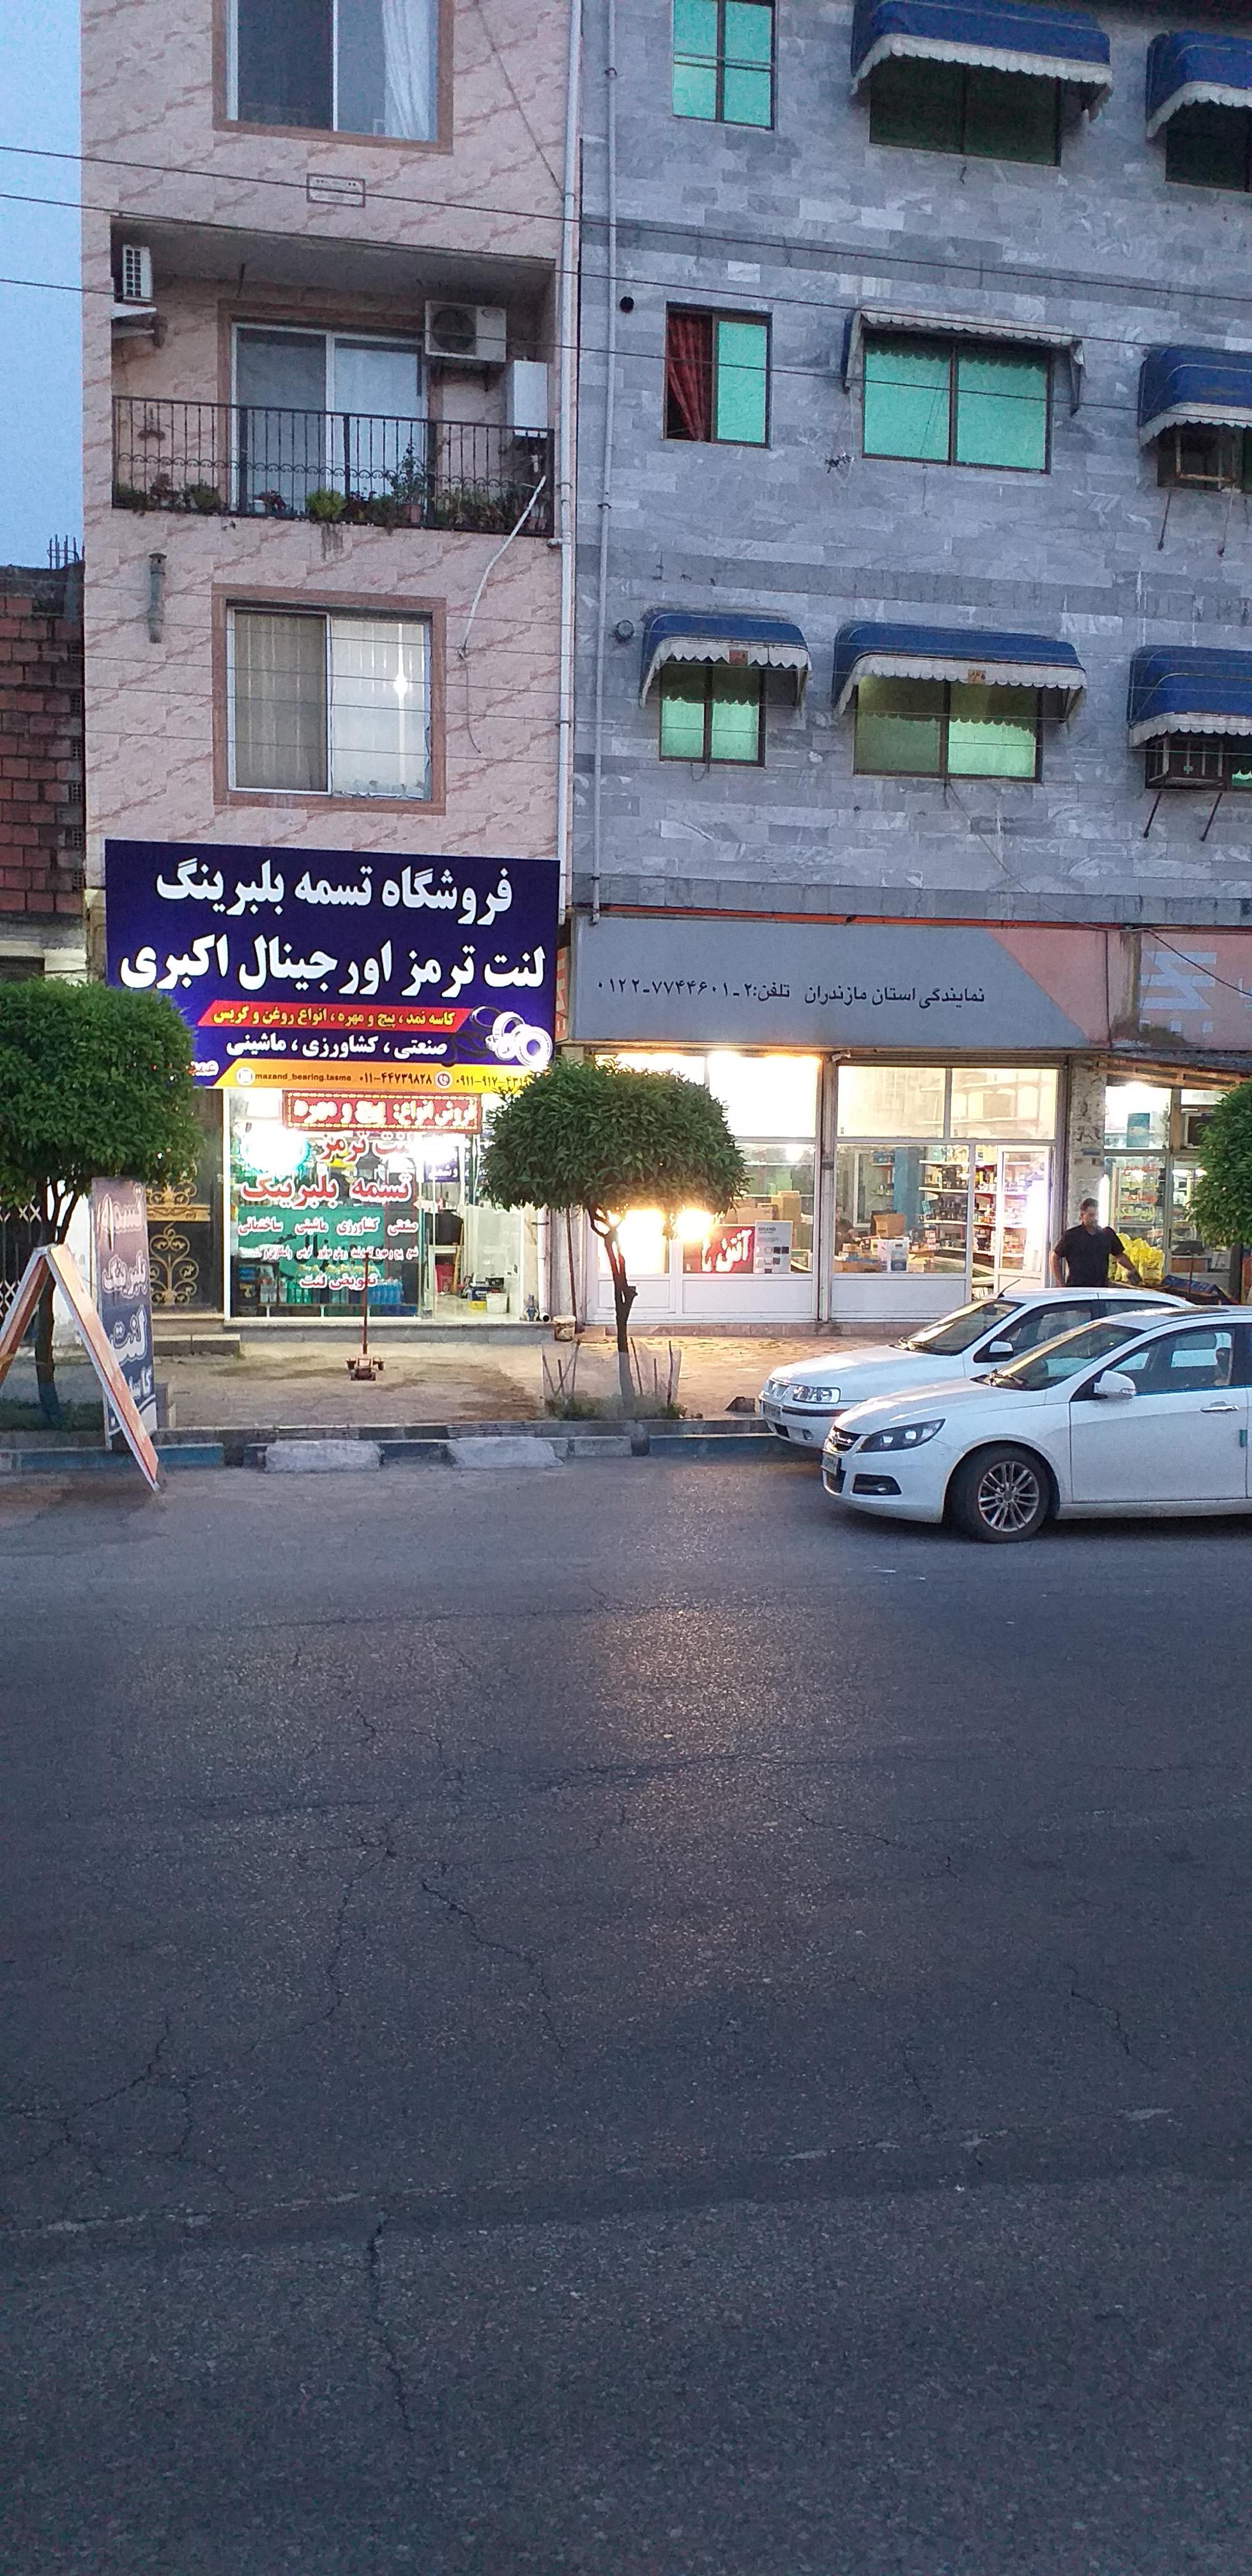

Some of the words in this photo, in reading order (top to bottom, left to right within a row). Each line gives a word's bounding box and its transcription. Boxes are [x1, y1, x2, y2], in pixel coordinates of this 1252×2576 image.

[156, 857, 285, 916] بلبرینگ
[294, 865, 374, 907] تسمه
[381, 867, 514, 925] فروشگاه
[119, 933, 229, 990] اکبری
[238, 935, 393, 995] اورجینال
[400, 944, 475, 998] ترمز
[484, 946, 546, 988] لنت
[804, 985, 867, 1006] مازندران
[871, 986, 915, 1005] استان
[919, 987, 985, 1009] نمایندگی
[213, 1005, 250, 1024] گریس
[252, 1010, 259, 1025] و
[262, 1007, 294, 1025] روغن
[297, 1007, 327, 1026] انواع
[337, 1011, 364, 1027] مهره
[367, 1015, 374, 1026] و
[377, 1012, 395, 1029] پیچ
[406, 1011, 426, 1025] نمد
[429, 1010, 455, 1025] کاسه
[226, 1032, 287, 1056] ماشینی
[302, 1034, 379, 1059] کشاورزی
[393, 1038, 448, 1060] صنعتی
[316, 1130, 370, 1163] ترمز
[349, 1173, 413, 1203] تسمه
[336, 1216, 381, 1236] کشاورزی
[111, 1305, 147, 1366] لنت
